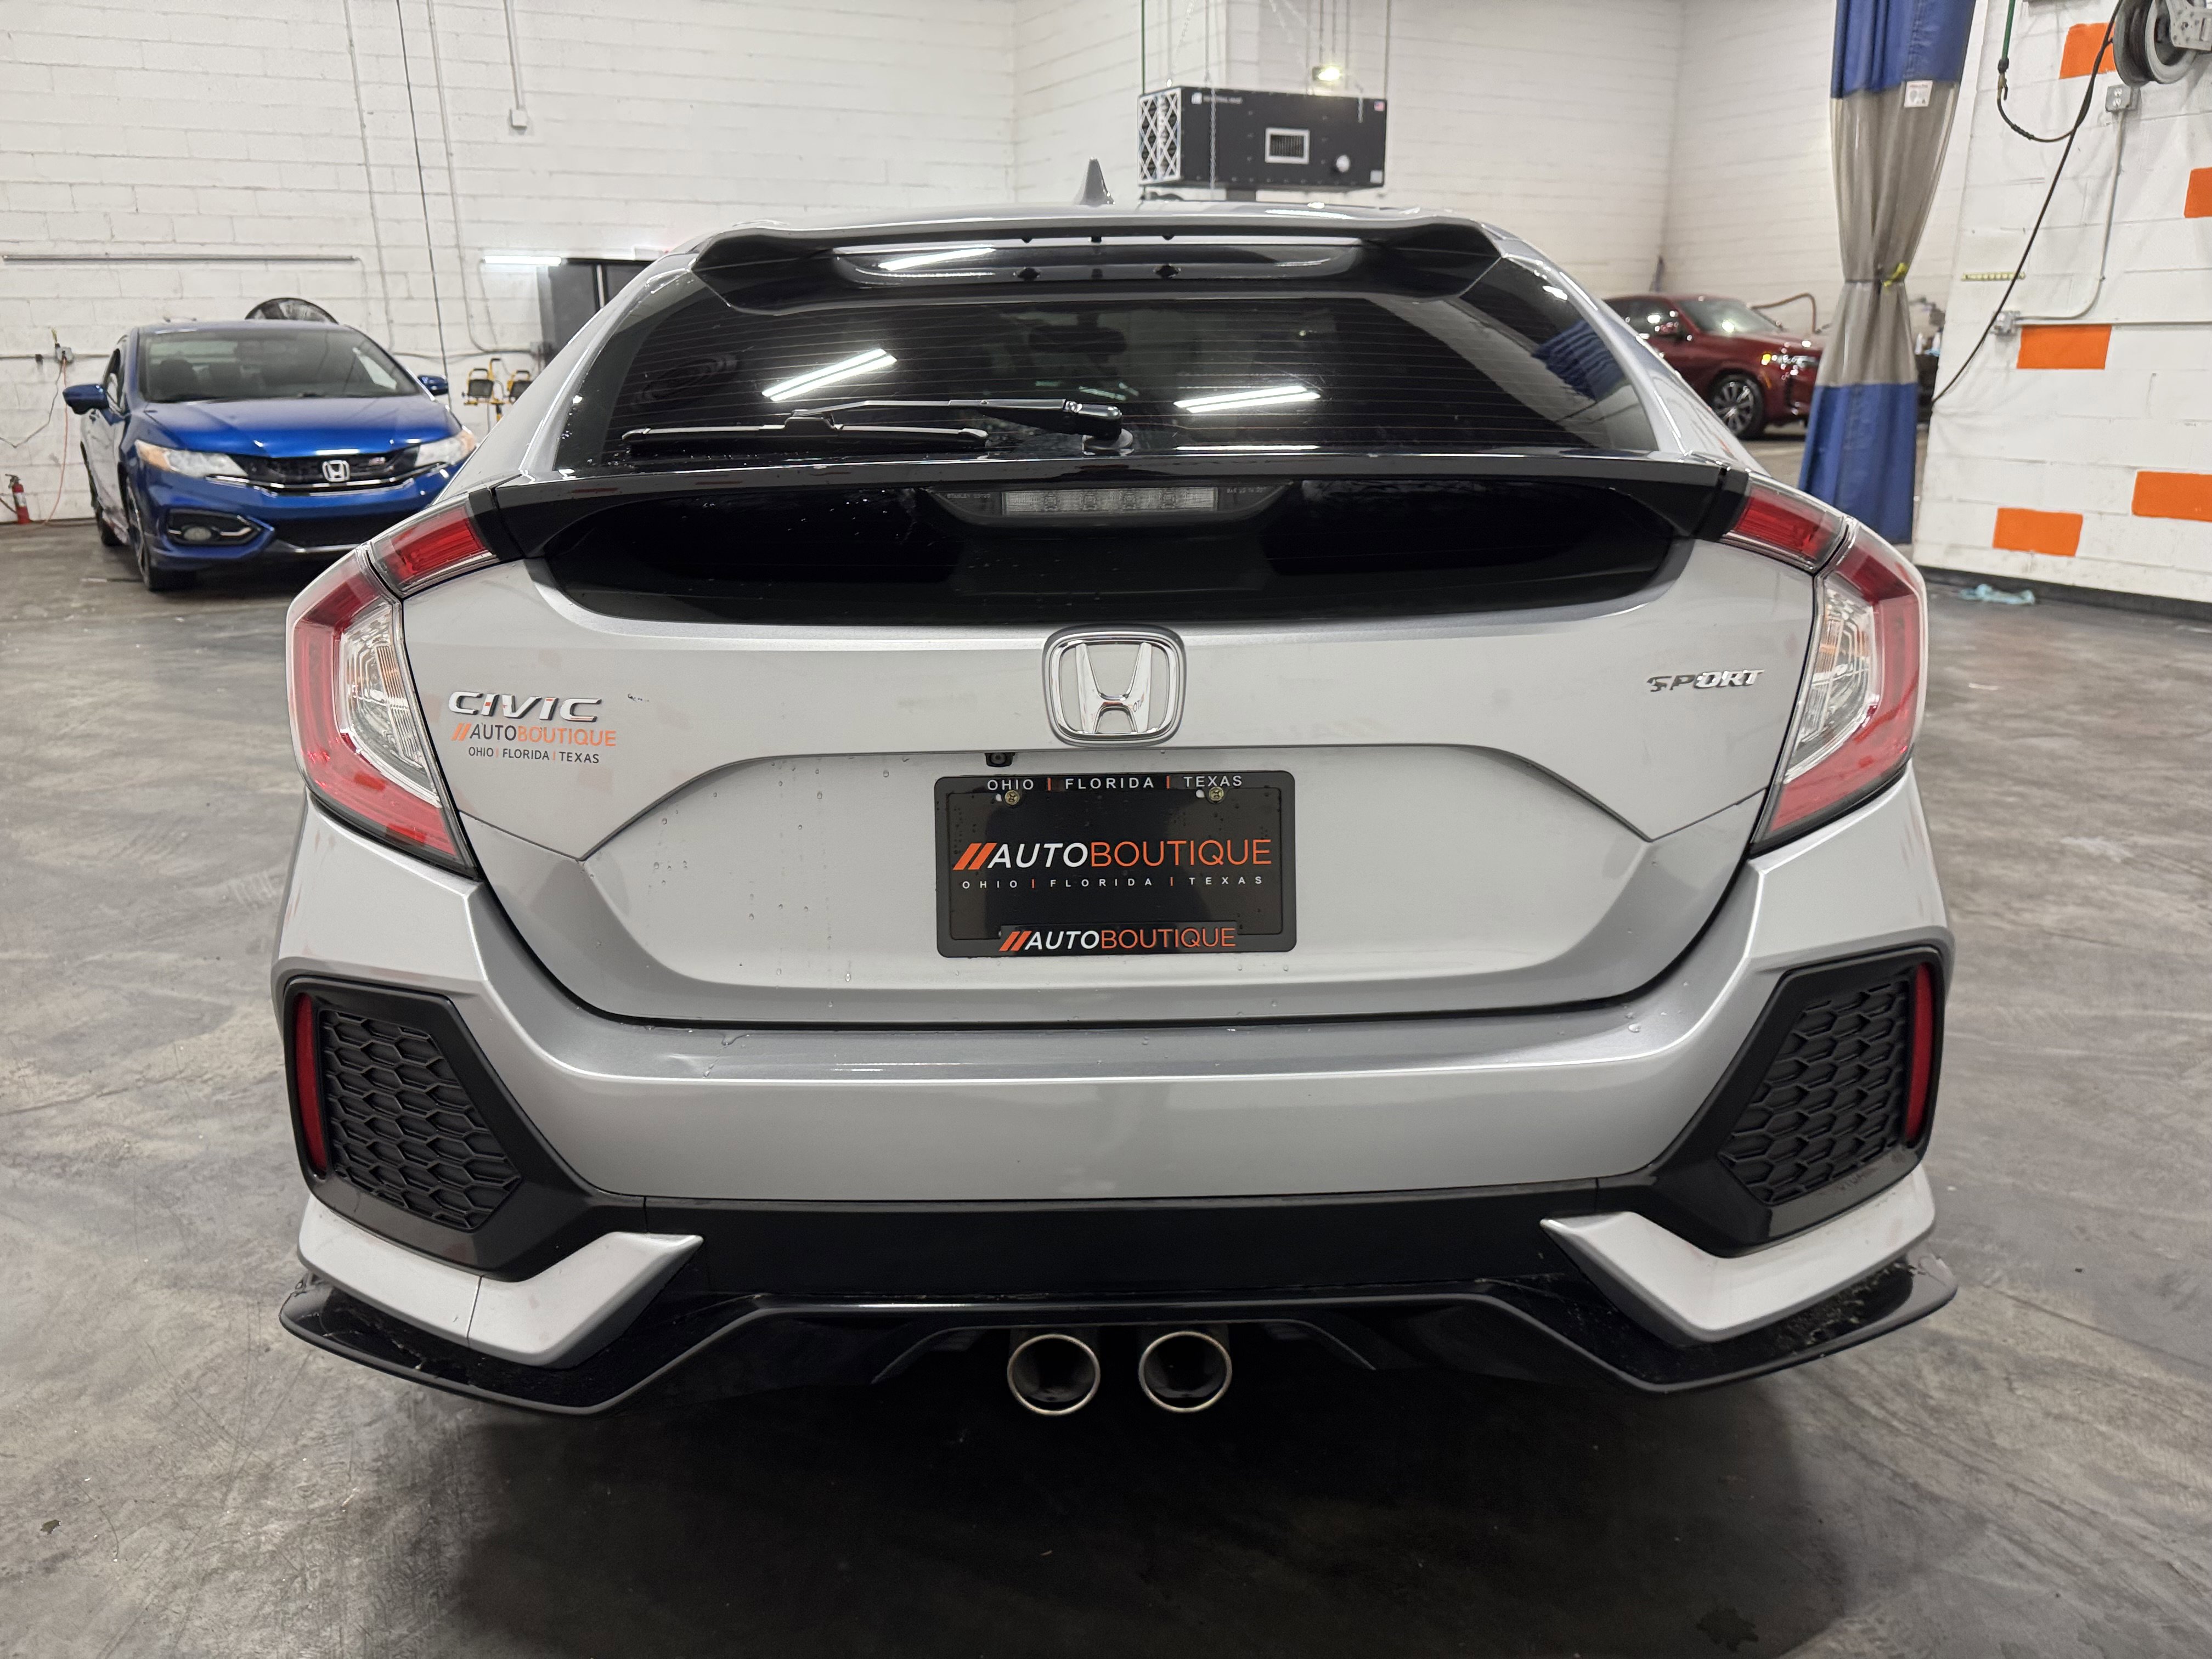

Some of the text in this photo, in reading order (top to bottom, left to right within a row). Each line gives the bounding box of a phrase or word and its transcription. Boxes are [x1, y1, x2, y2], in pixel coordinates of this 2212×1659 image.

[1646, 669, 1765, 692] SPORT
[448, 691, 602, 723] CIVIC
[470, 724, 617, 747] AUTOBOUTIQUE
[468, 746, 600, 764] OHIO FLORIDA TEXAS
[987, 775, 1243, 791] OHIO FLORIDA TEXAS
[987, 839, 1272, 869] AUTOBOUTIQUE
[962, 876, 1263, 889] OHIO FLORIDA TEXAS
[1024, 927, 1237, 951] AUTOBOUTIQUE
